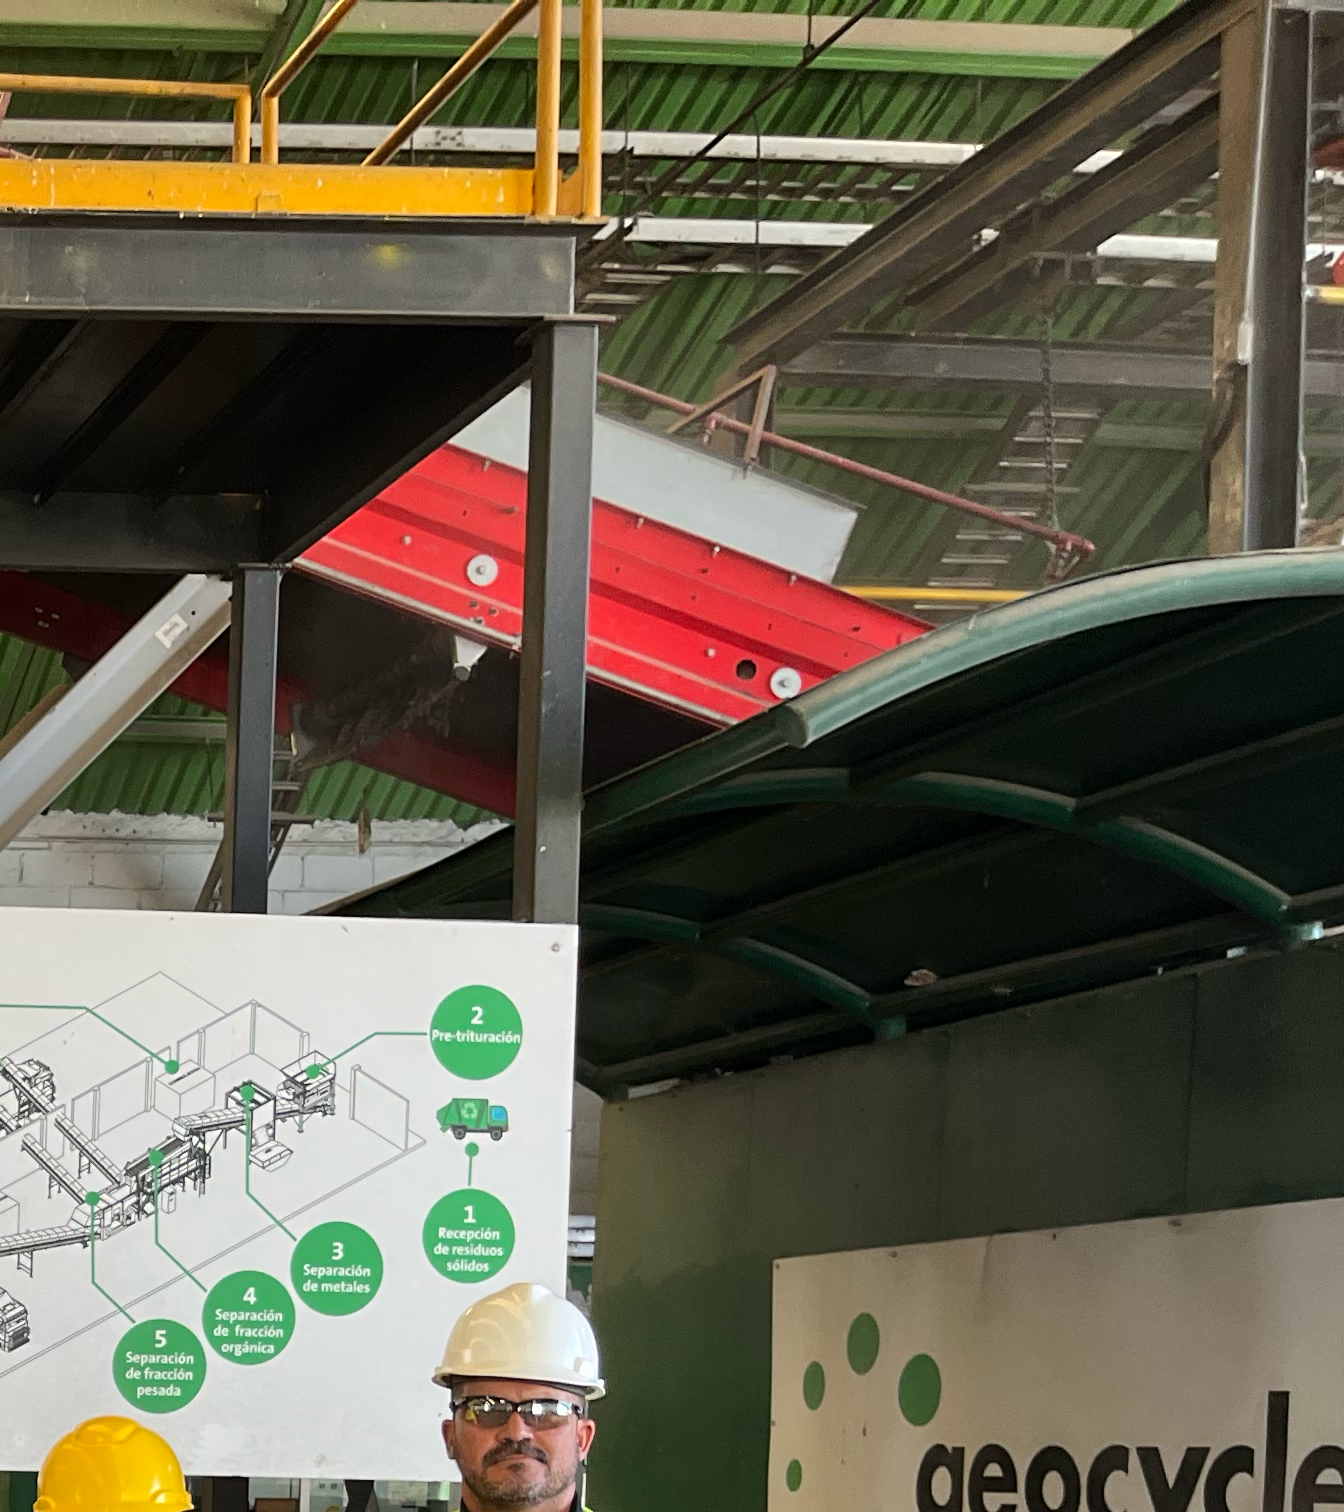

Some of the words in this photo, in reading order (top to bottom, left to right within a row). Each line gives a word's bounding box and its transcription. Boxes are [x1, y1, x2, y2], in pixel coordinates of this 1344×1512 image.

[470, 1006, 484, 1025] 2
[432, 1029, 521, 1044] Pre-trituración
[463, 1205, 477, 1224] 1
[437, 1226, 501, 1244] Recepción
[331, 1241, 344, 1261] 3
[433, 1242, 450, 1255] de
[452, 1243, 504, 1257] residuos
[303, 1261, 371, 1279] Separación
[446, 1257, 490, 1273] sólidos
[242, 1286, 257, 1305] 4
[302, 1279, 319, 1292] de
[320, 1279, 371, 1294] metales
[214, 1308, 283, 1326] Separación
[154, 1329, 167, 1348] 5
[213, 1323, 230, 1337] de
[234, 1323, 284, 1338] fracción
[221, 1340, 275, 1356] orgánica
[125, 1350, 194, 1369] Separación
[125, 1366, 142, 1380] de
[144, 1366, 194, 1381] fracción
[136, 1382, 182, 1398] pesada
